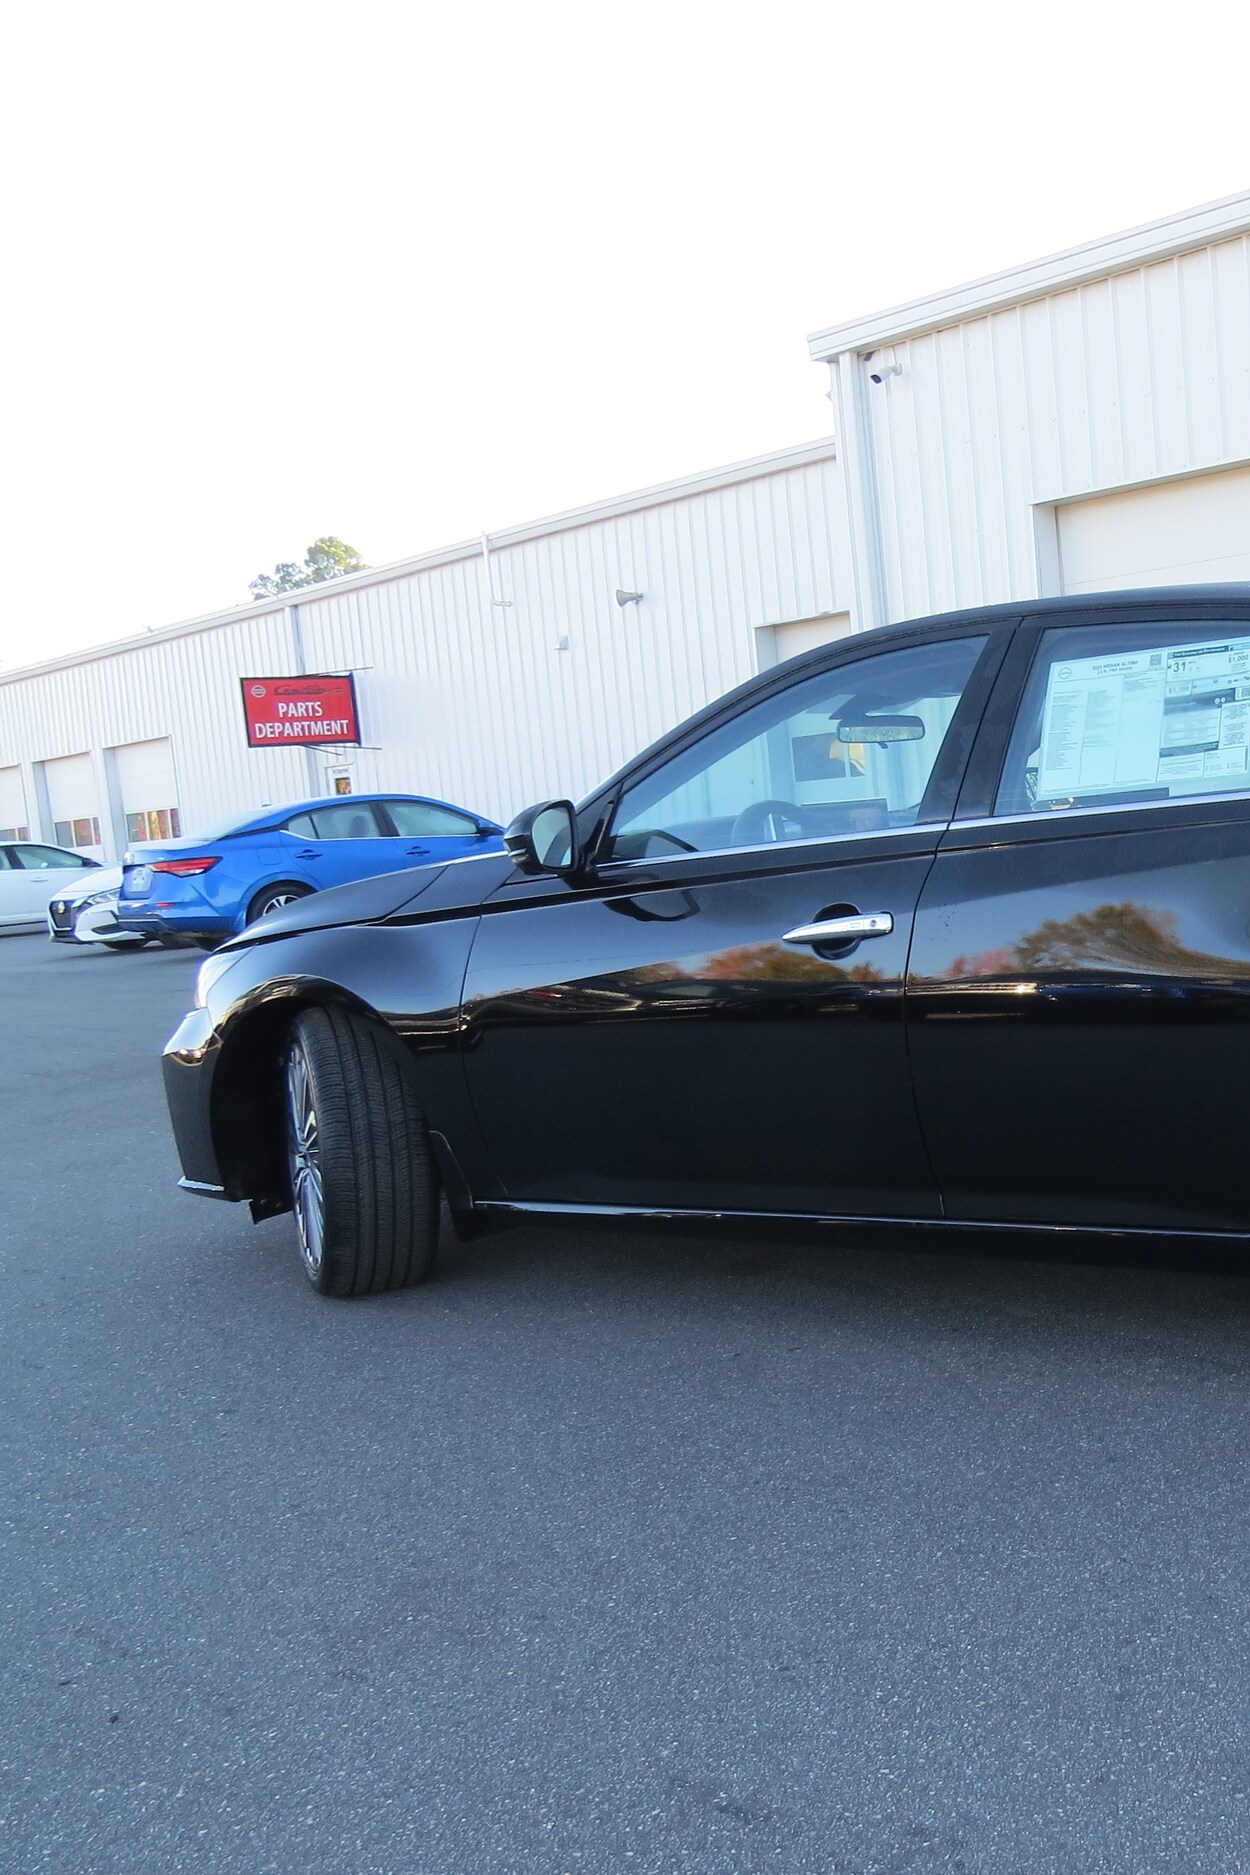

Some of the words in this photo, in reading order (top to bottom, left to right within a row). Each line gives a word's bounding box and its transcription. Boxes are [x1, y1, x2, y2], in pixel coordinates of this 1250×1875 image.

[1173, 661, 1186, 672] 31
[278, 702, 323, 718] PARTS
[255, 720, 349, 738] DEPARTMENT
